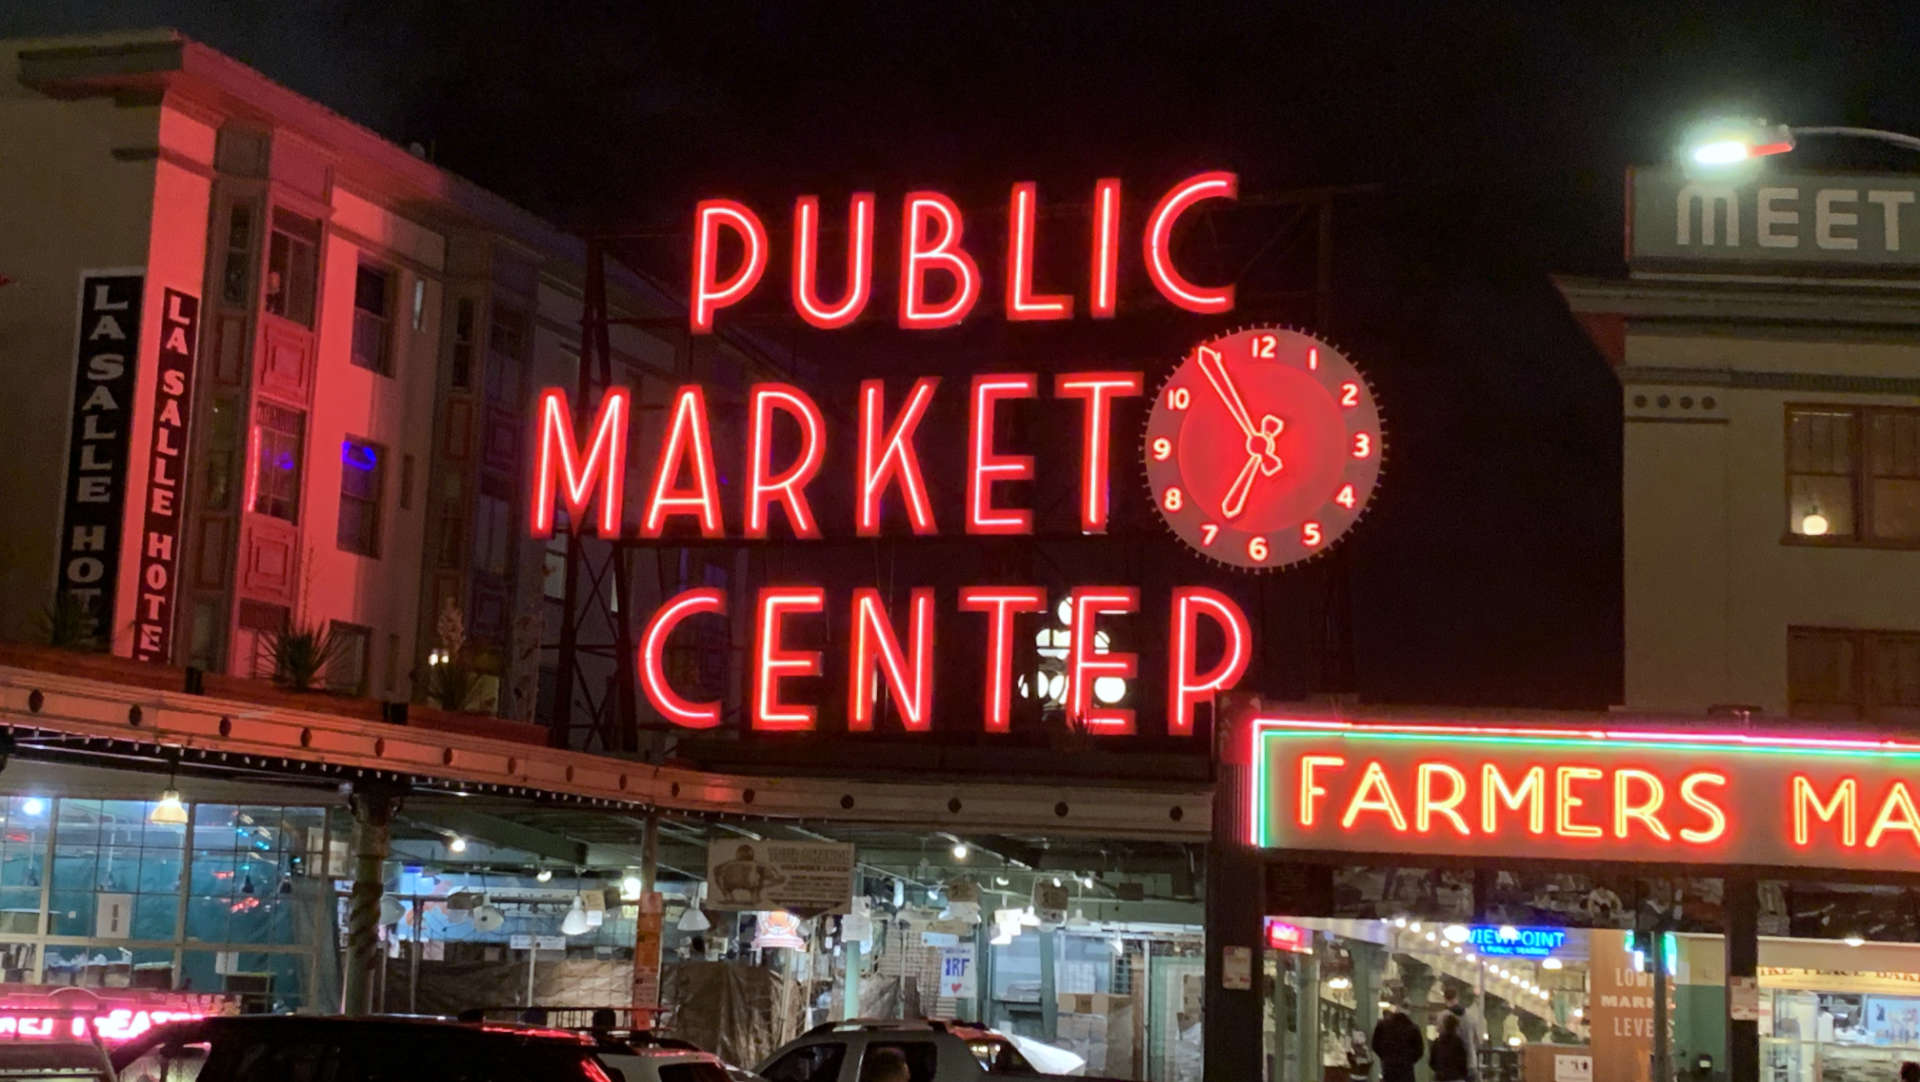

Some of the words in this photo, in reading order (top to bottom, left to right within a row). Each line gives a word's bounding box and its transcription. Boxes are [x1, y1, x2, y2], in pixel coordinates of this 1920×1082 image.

[1676, 182, 1915, 251] MEET
[690, 171, 1239, 334] PUBLIC
[166, 295, 191, 356] LA
[1251, 335, 1277, 358] 12
[1309, 348, 1317, 370] 1
[1167, 387, 1190, 410] 10
[1341, 383, 1359, 406] 2
[77, 353, 125, 503] SALLE
[151, 369, 186, 517] SALLE
[1152, 438, 1171, 461] 9
[1353, 433, 1371, 457] 3
[530, 372, 1144, 539] MARKET
[1164, 487, 1182, 511] 8
[1336, 484, 1355, 508] 4
[1201, 524, 1219, 546] 7
[1303, 523, 1321, 545] 5
[1249, 537, 1268, 561] 6
[139, 531, 173, 661] HOTE
[1298, 754, 1729, 845] FARMERS
